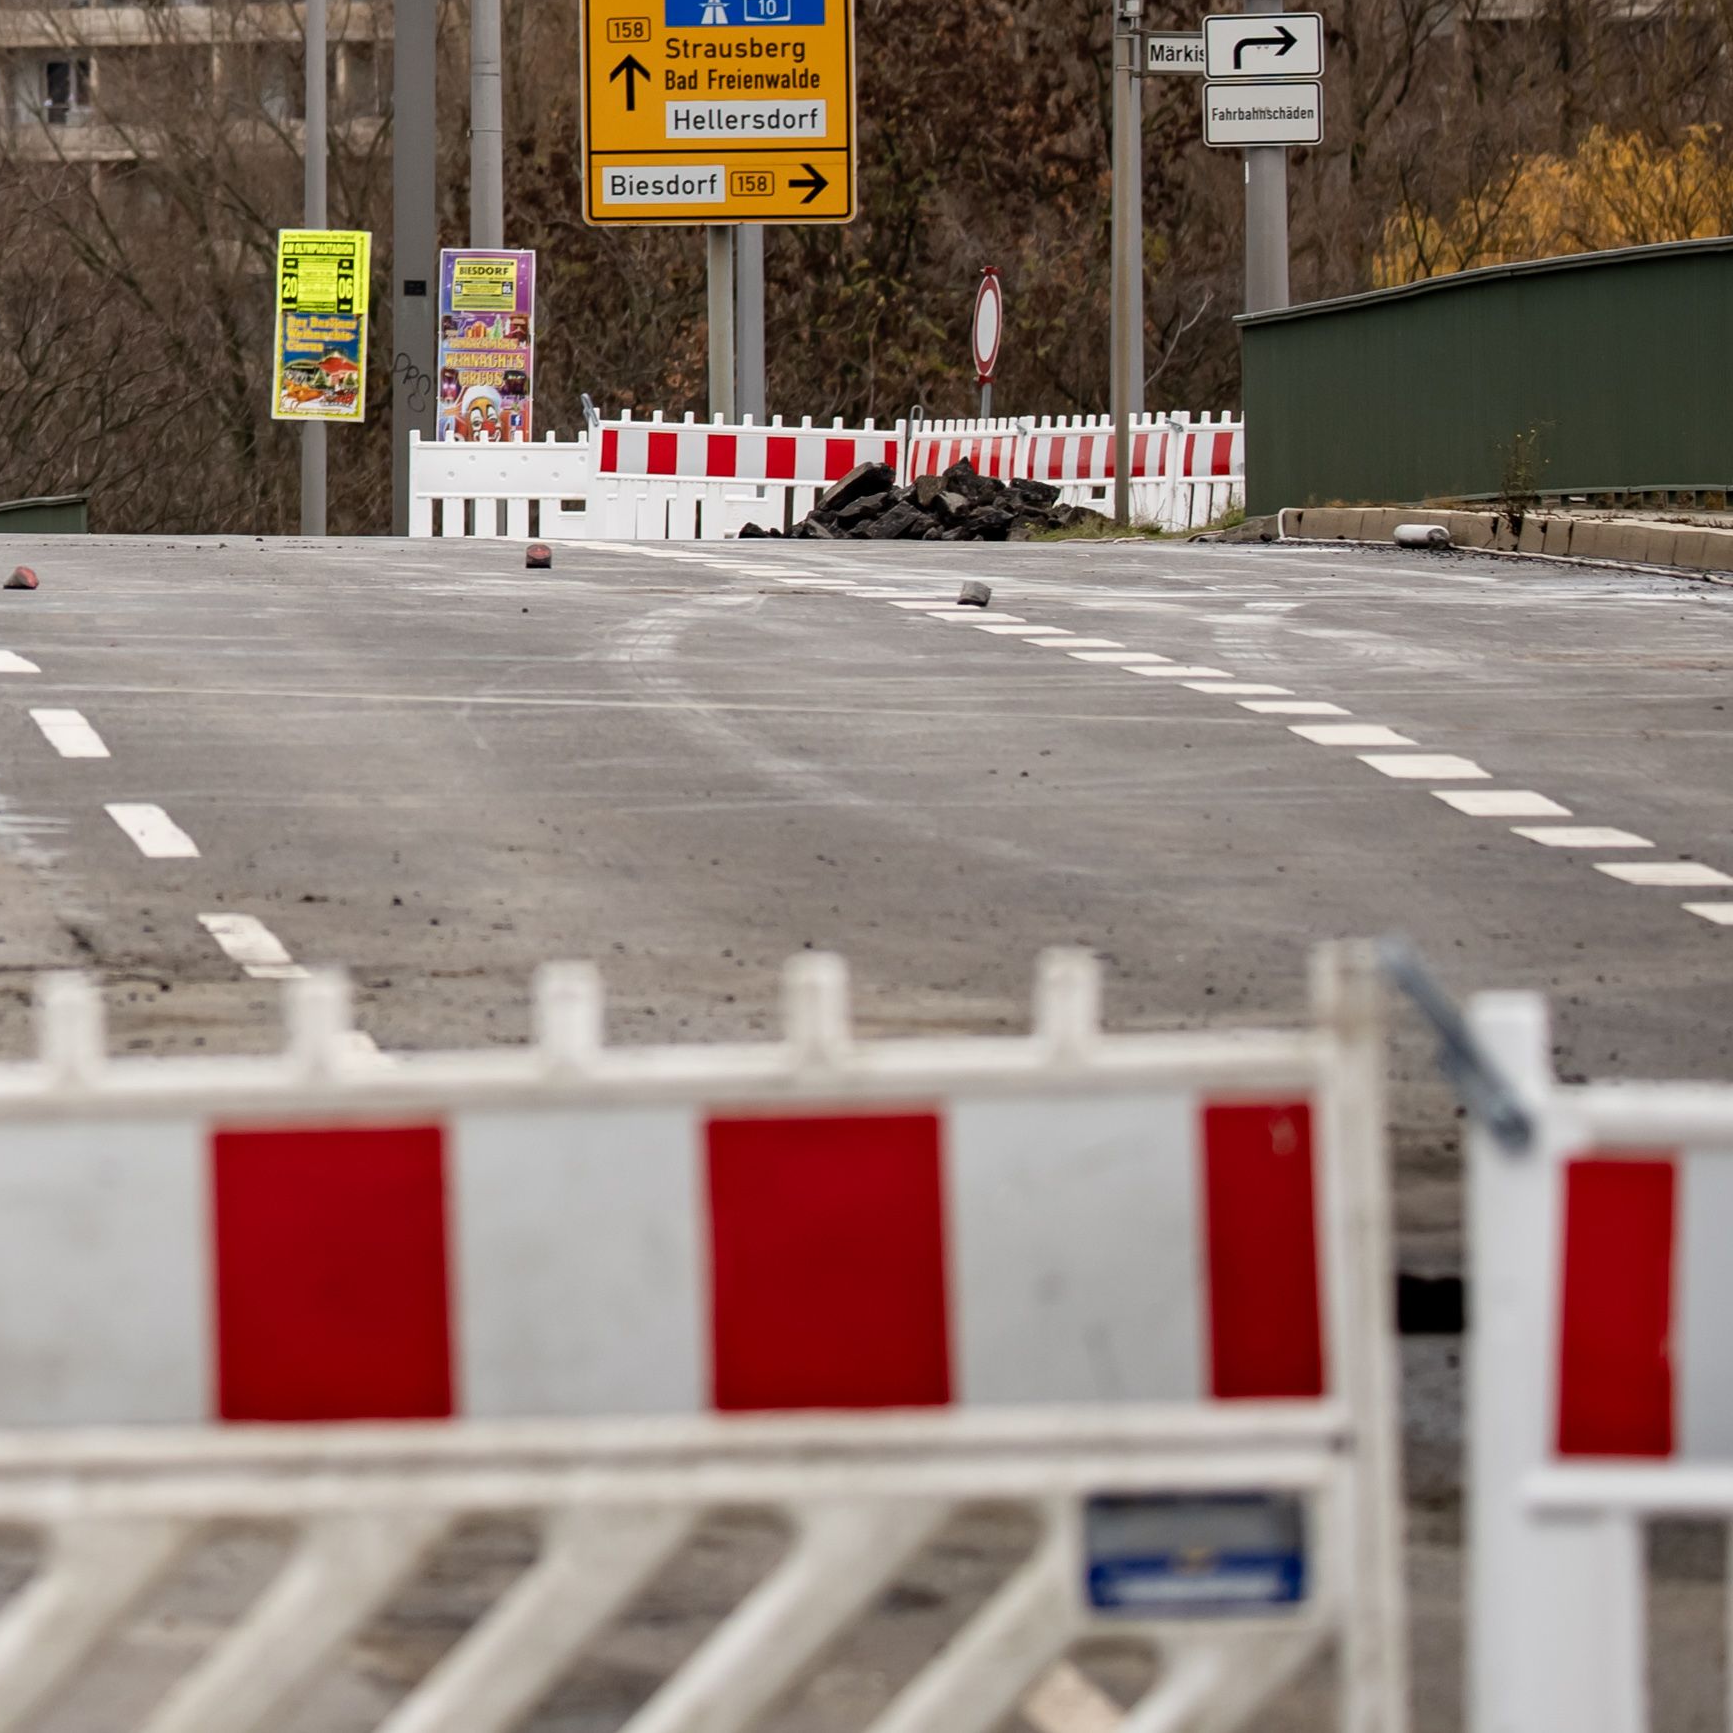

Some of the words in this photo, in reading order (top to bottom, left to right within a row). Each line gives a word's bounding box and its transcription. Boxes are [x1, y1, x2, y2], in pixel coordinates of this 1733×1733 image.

[612, 21, 645, 39] 158
[665, 37, 806, 63] Strausberg
[665, 69, 698, 90] Bad
[708, 68, 821, 90] Freienwalde
[673, 108, 819, 131] Hellersdorf
[1212, 105, 1315, 122] Fahrbahnschäden
[610, 173, 718, 197] Biesdorf
[736, 175, 768, 193] 158
[459, 266, 509, 276] BIESDORF
[283, 276, 298, 299] 20
[338, 277, 353, 300] 06
